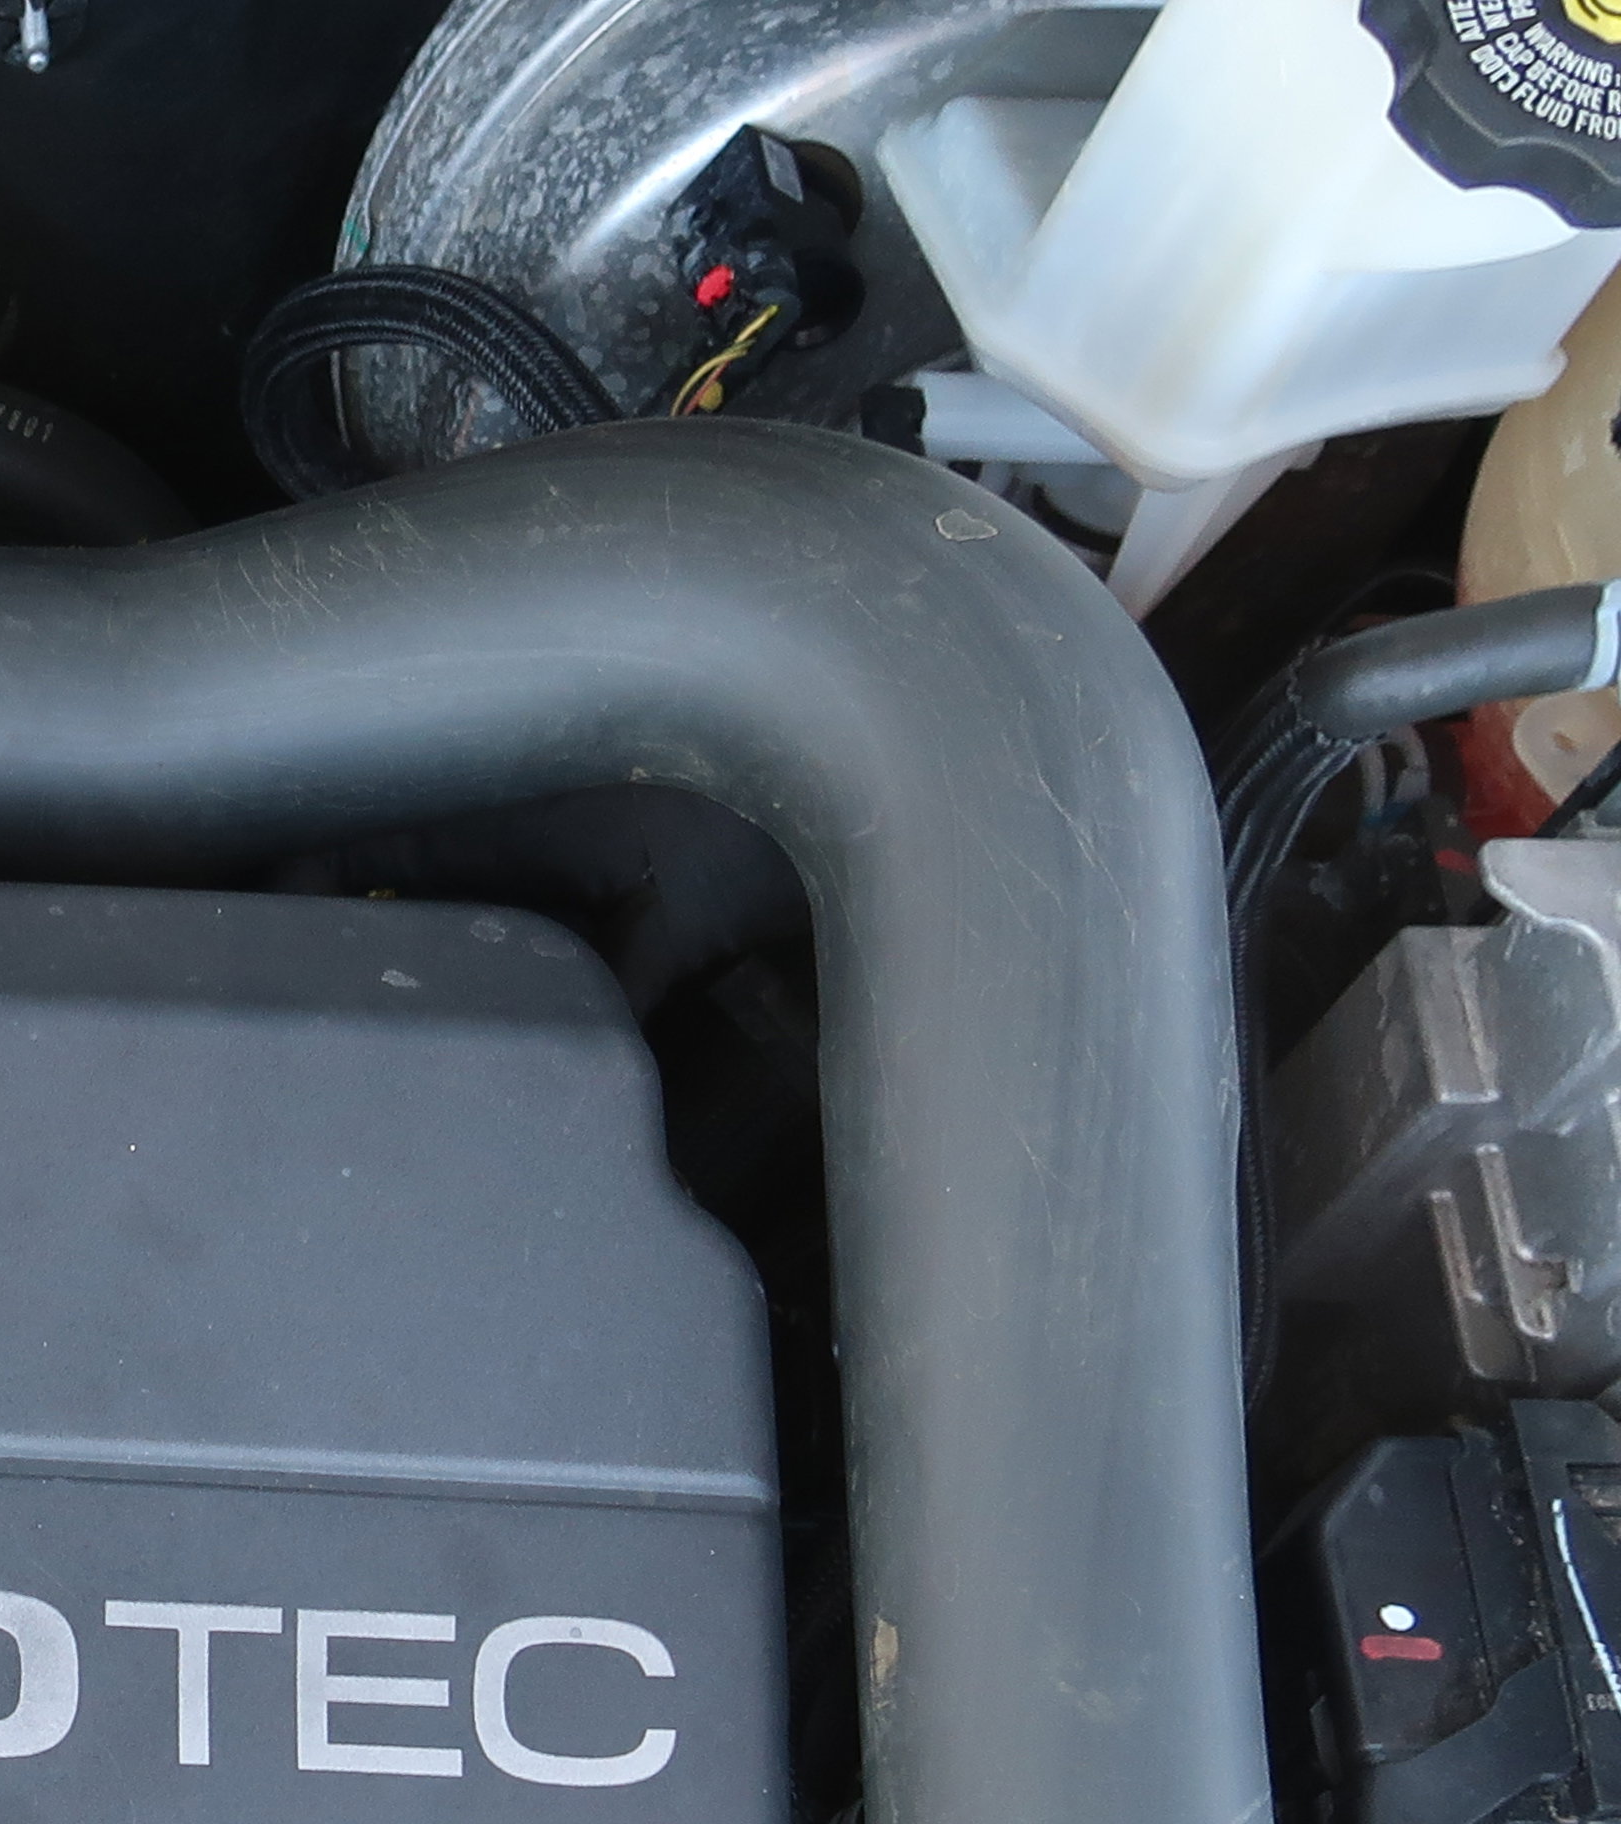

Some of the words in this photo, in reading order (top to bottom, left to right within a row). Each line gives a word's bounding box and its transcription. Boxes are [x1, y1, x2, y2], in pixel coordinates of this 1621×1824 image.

[1469, 43, 1521, 93] DOT3
[1510, 81, 1574, 128] FLUID
[1495, 32, 1536, 66] CAP
[1525, 59, 1605, 111] BEFORE
